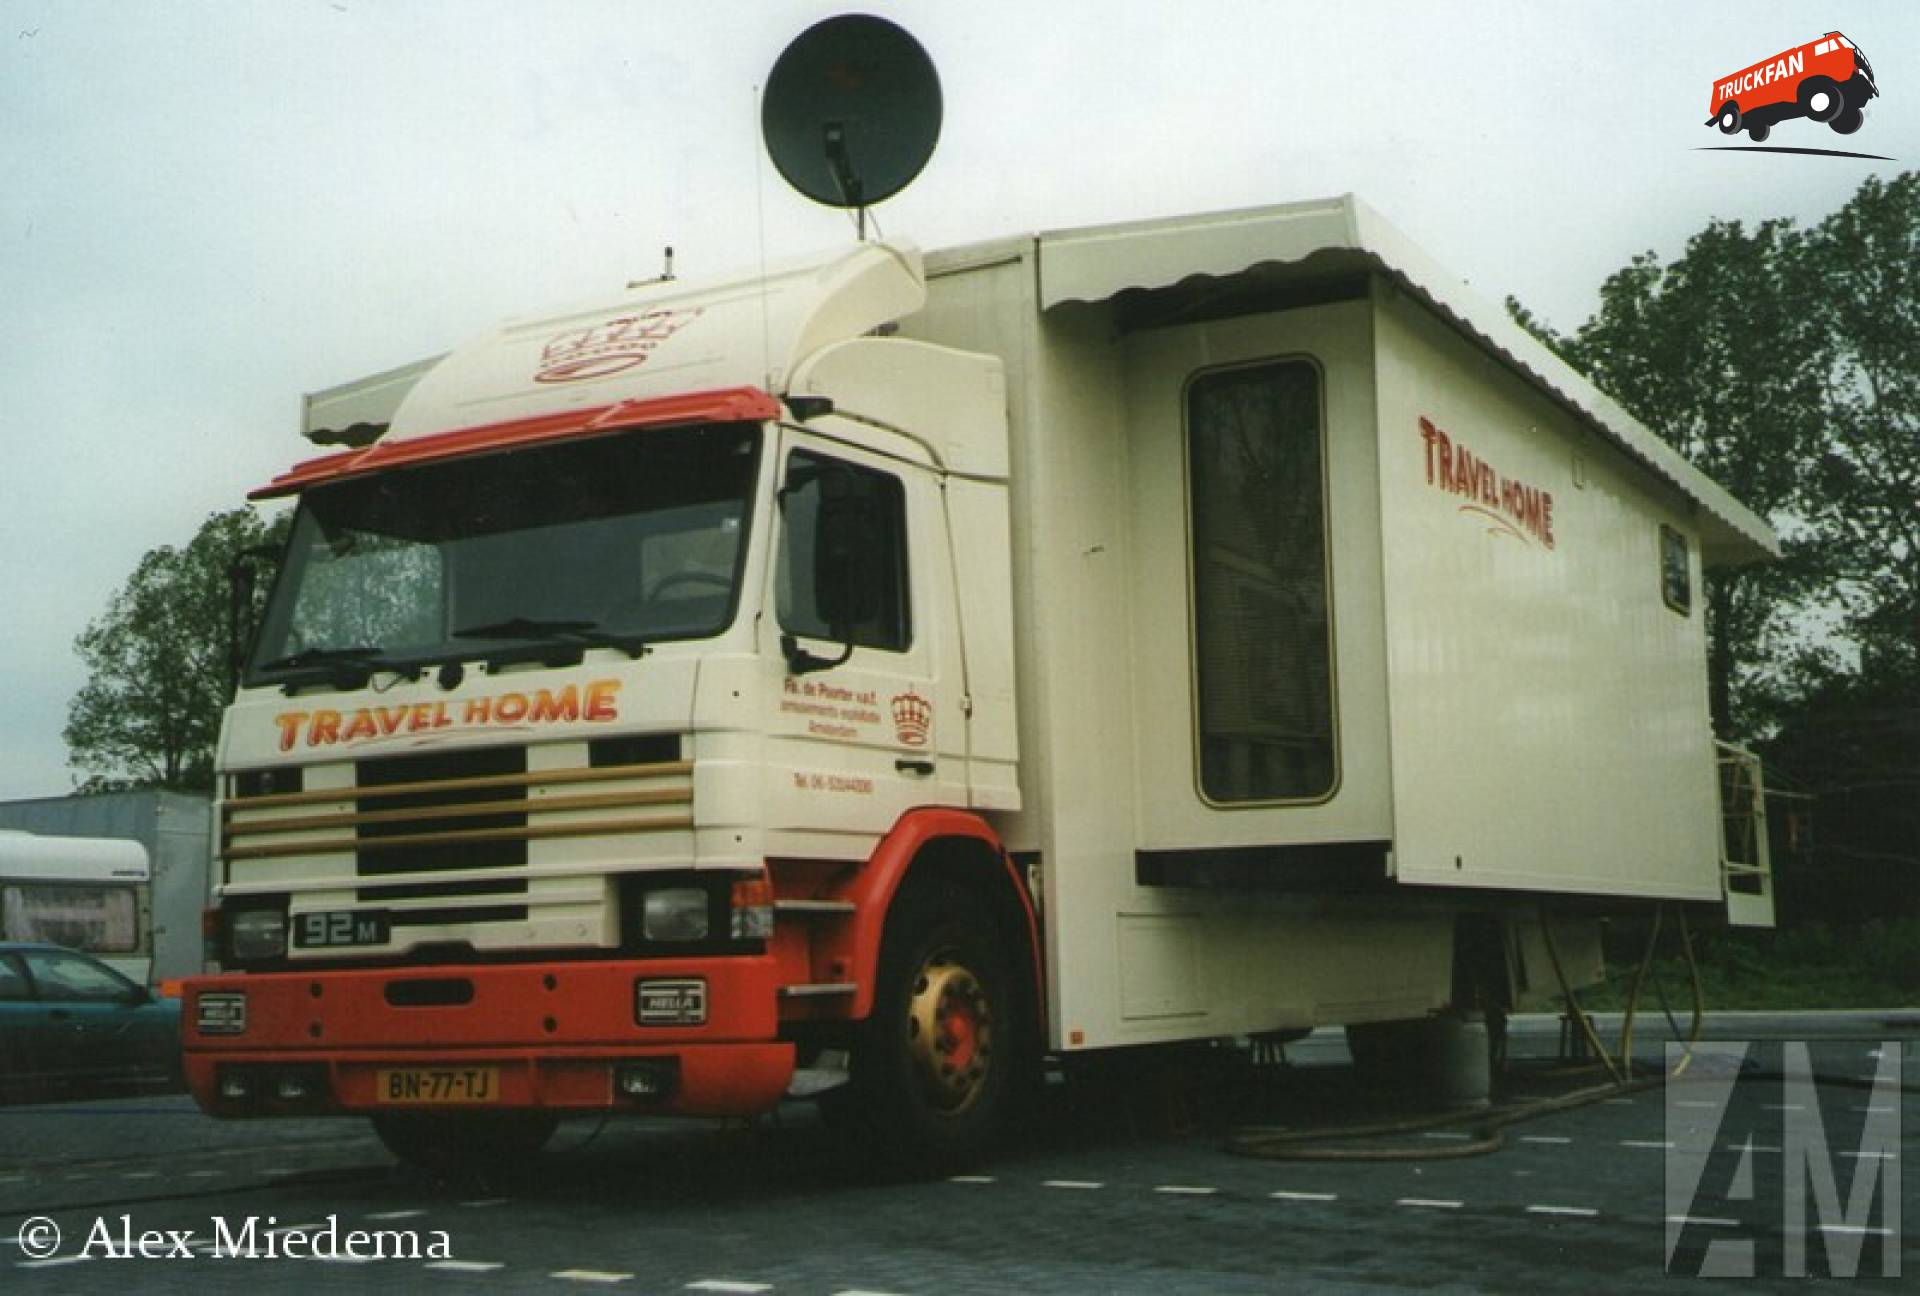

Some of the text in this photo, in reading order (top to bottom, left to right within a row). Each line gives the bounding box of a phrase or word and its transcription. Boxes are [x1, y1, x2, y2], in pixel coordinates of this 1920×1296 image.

[1418, 415, 1555, 550] TRAVEL HOME
[275, 679, 622, 752] TRAVEL HOME
[388, 1067, 489, 1098] BN-77-TJ
